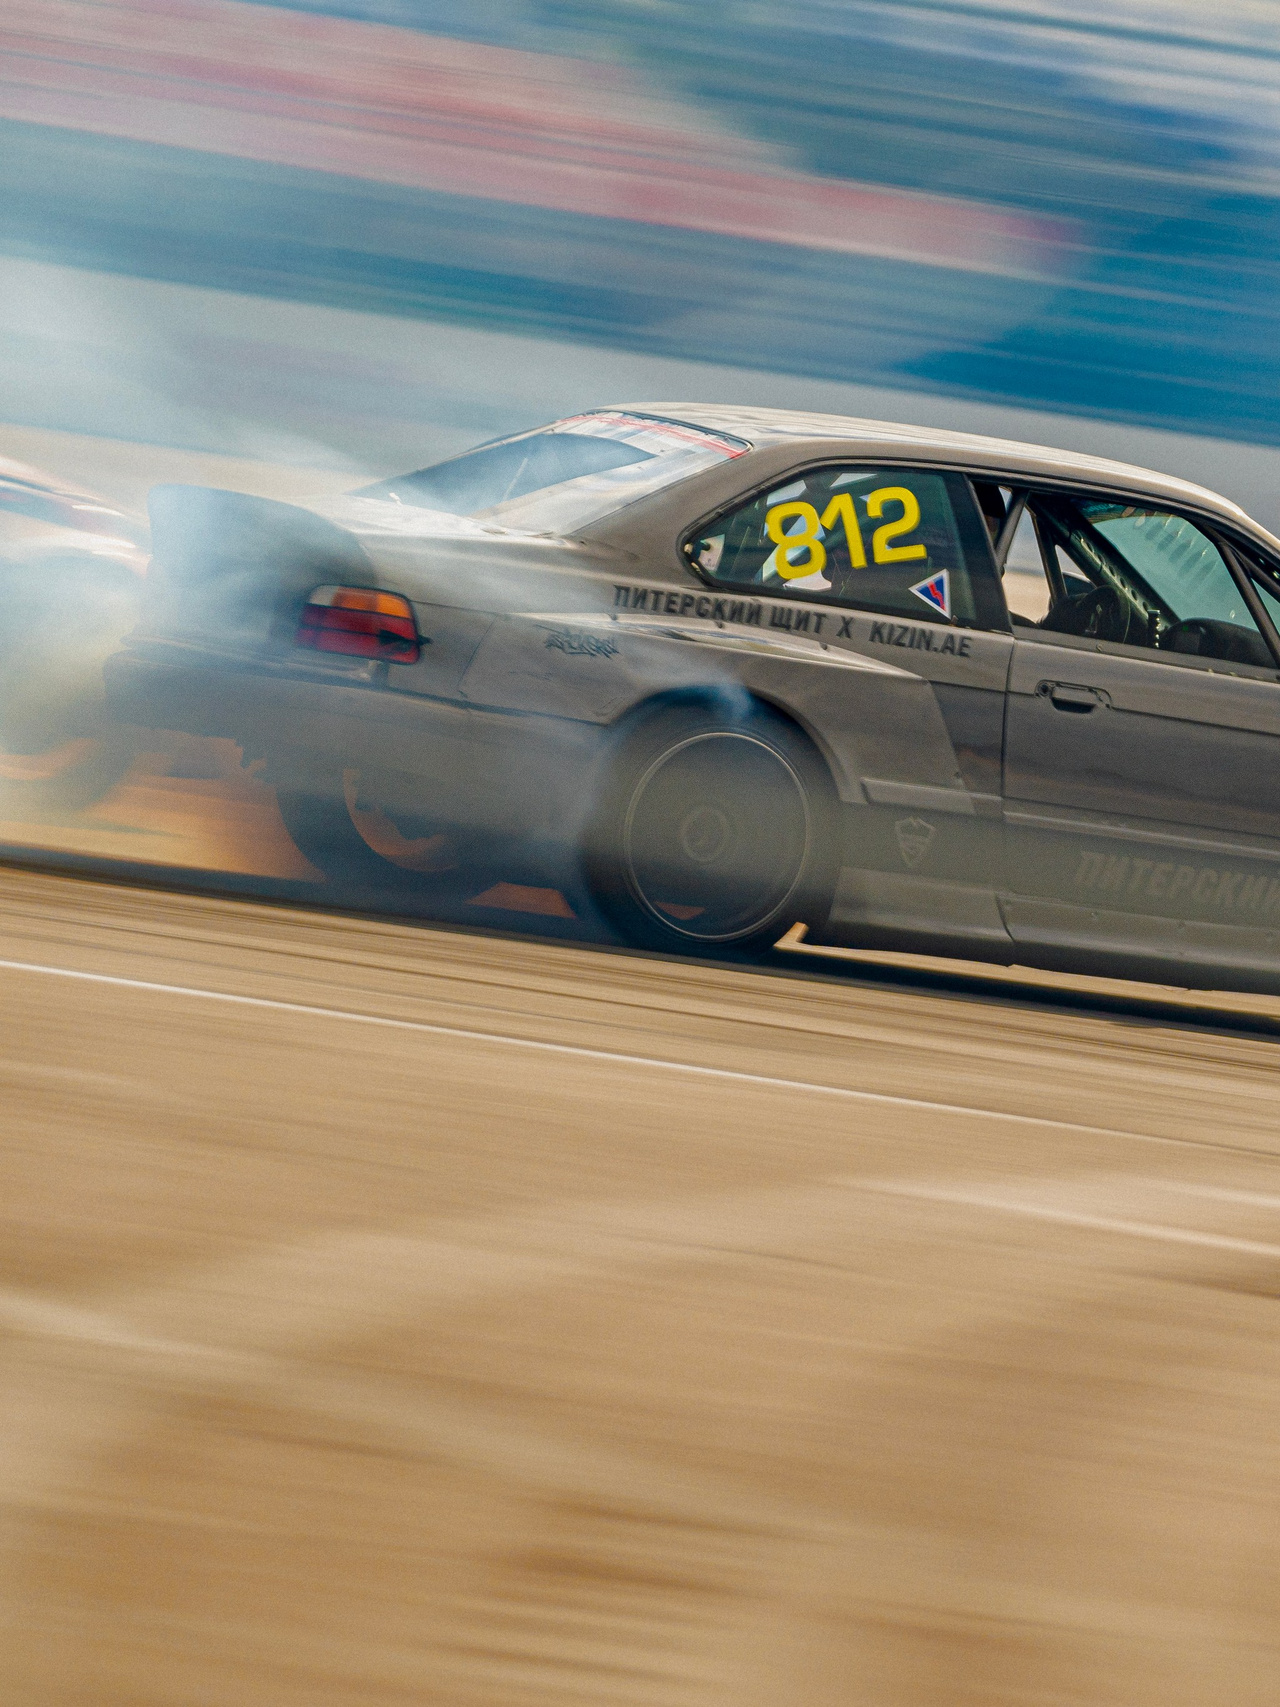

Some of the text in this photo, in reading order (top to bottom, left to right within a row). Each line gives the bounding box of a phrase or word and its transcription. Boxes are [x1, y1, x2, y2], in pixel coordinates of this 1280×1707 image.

[766, 486, 927, 580] 812
[613, 584, 763, 626] ПИТЕРСКИЙ
[768, 605, 827, 634] ЩИТ
[868, 620, 973, 658] KIZIN.AE
